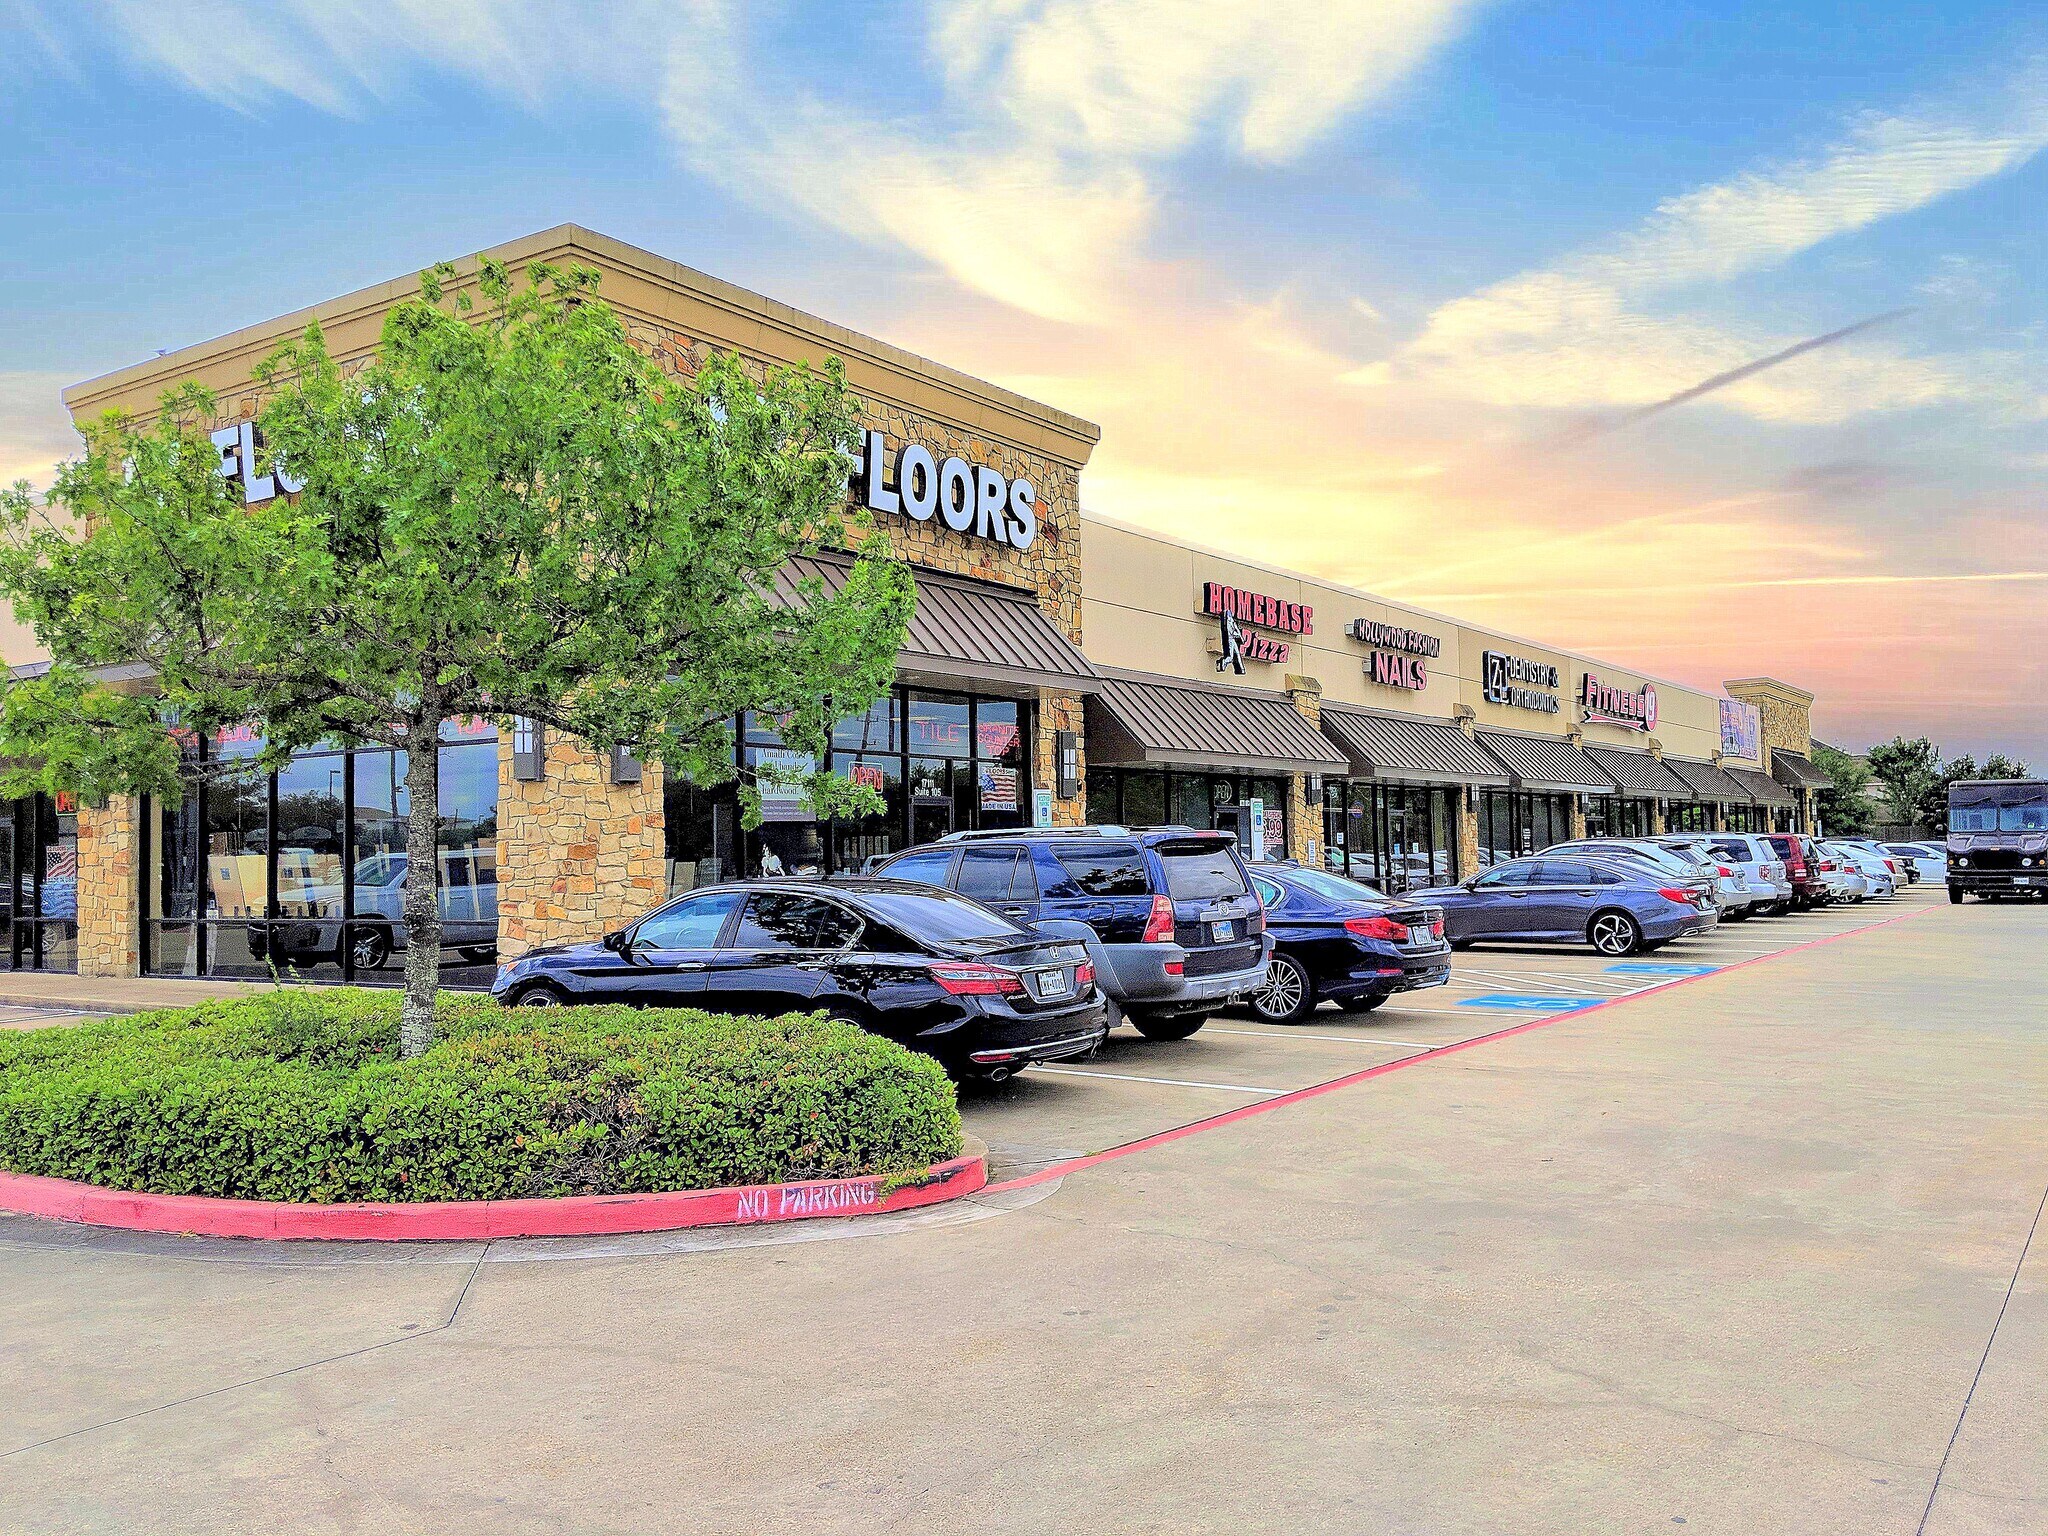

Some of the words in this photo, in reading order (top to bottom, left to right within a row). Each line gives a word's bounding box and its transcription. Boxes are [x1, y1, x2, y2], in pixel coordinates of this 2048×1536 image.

[1206, 582, 1314, 636] HOMEBASE
[1239, 628, 1290, 664] Pizza
[1357, 618, 1407, 650] HOLLYWOOD
[1408, 630, 1440, 658] FASHION
[1374, 651, 1428, 691] NAILS
[1509, 656, 1550, 686] DENTISTRY
[1510, 686, 1560, 714] ORTHODONTICS
[915, 720, 959, 742] TILE
[977, 723, 1019, 736] GRANITE
[977, 733, 1020, 748] COUNTER
[986, 744, 1010, 756] TOP
[851, 766, 883, 790] OPEN
[737, 1189, 769, 1219] NO
[779, 1182, 876, 1216] PARKING
